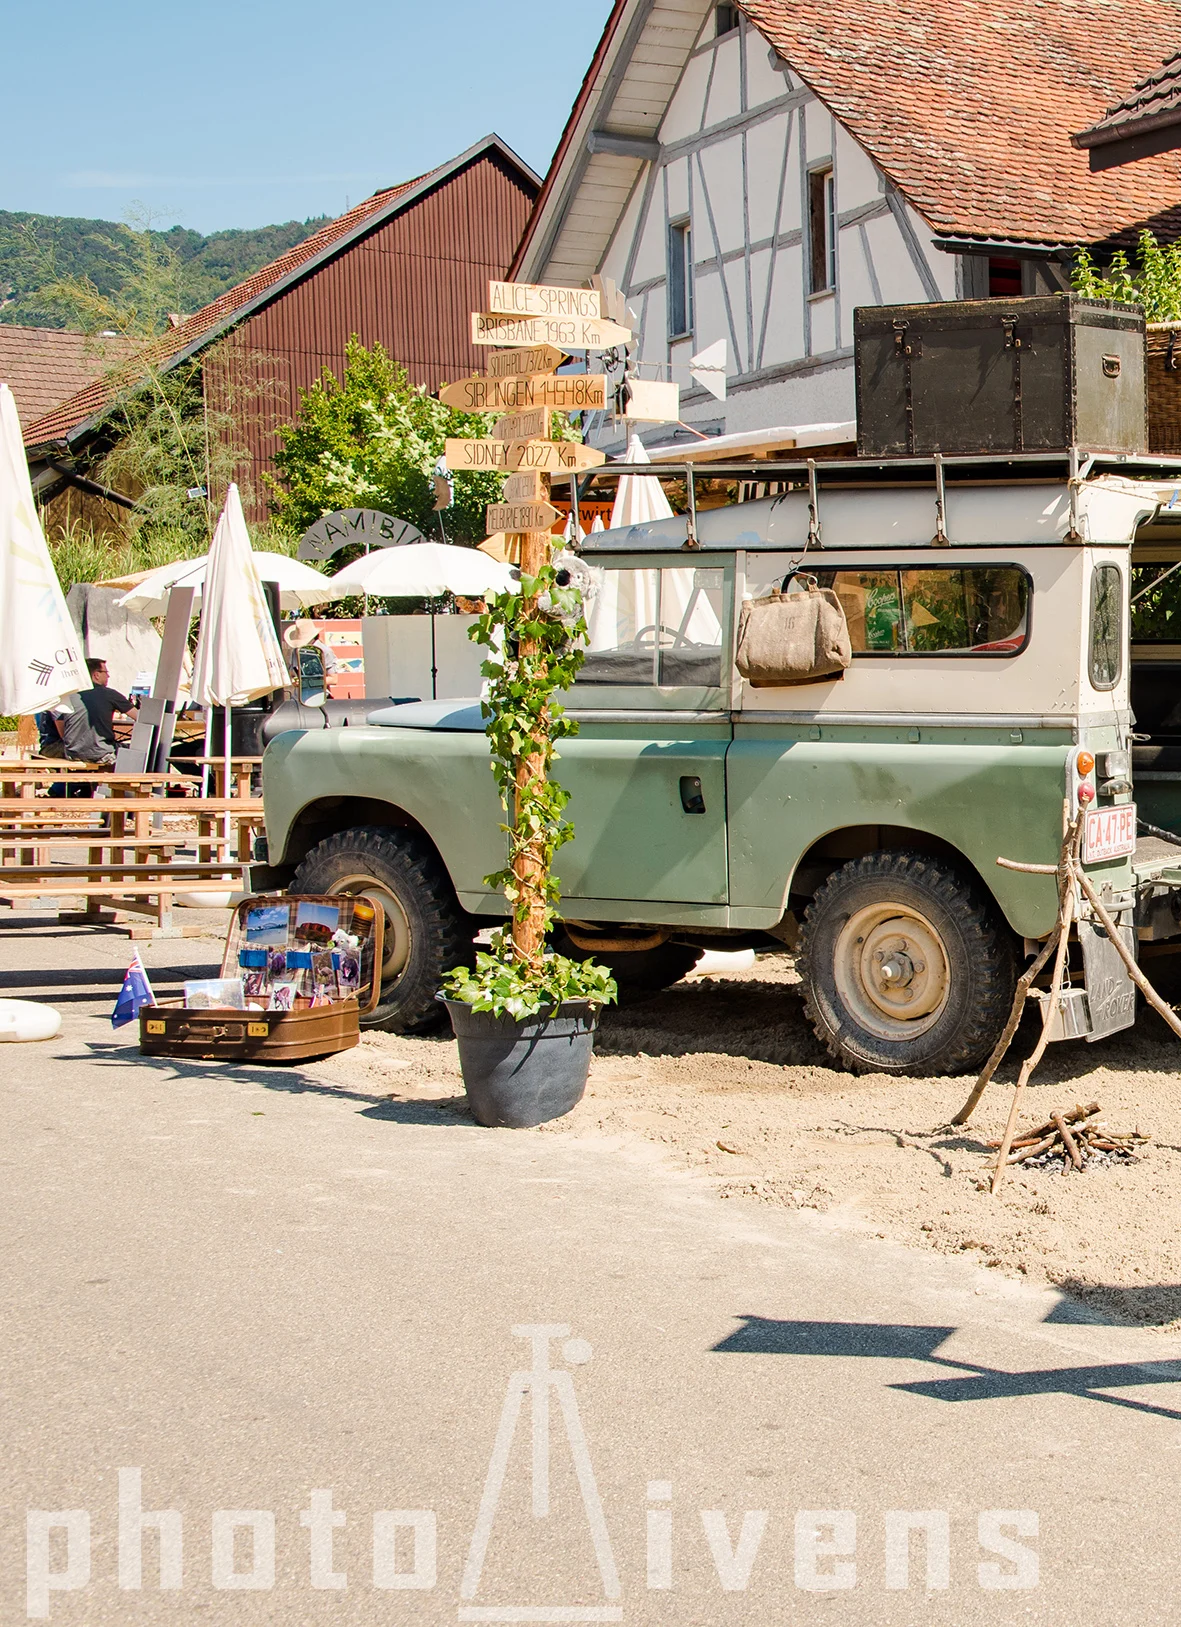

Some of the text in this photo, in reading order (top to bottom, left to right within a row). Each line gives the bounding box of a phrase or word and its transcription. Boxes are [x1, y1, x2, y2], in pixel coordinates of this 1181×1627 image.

[493, 285, 598, 317] ALICE SPRINGS
[476, 317, 601, 344] BRISBANE 1963 Km
[464, 381, 535, 408] SIBLINGEN
[464, 443, 577, 467] SIDNEY 2027 Km
